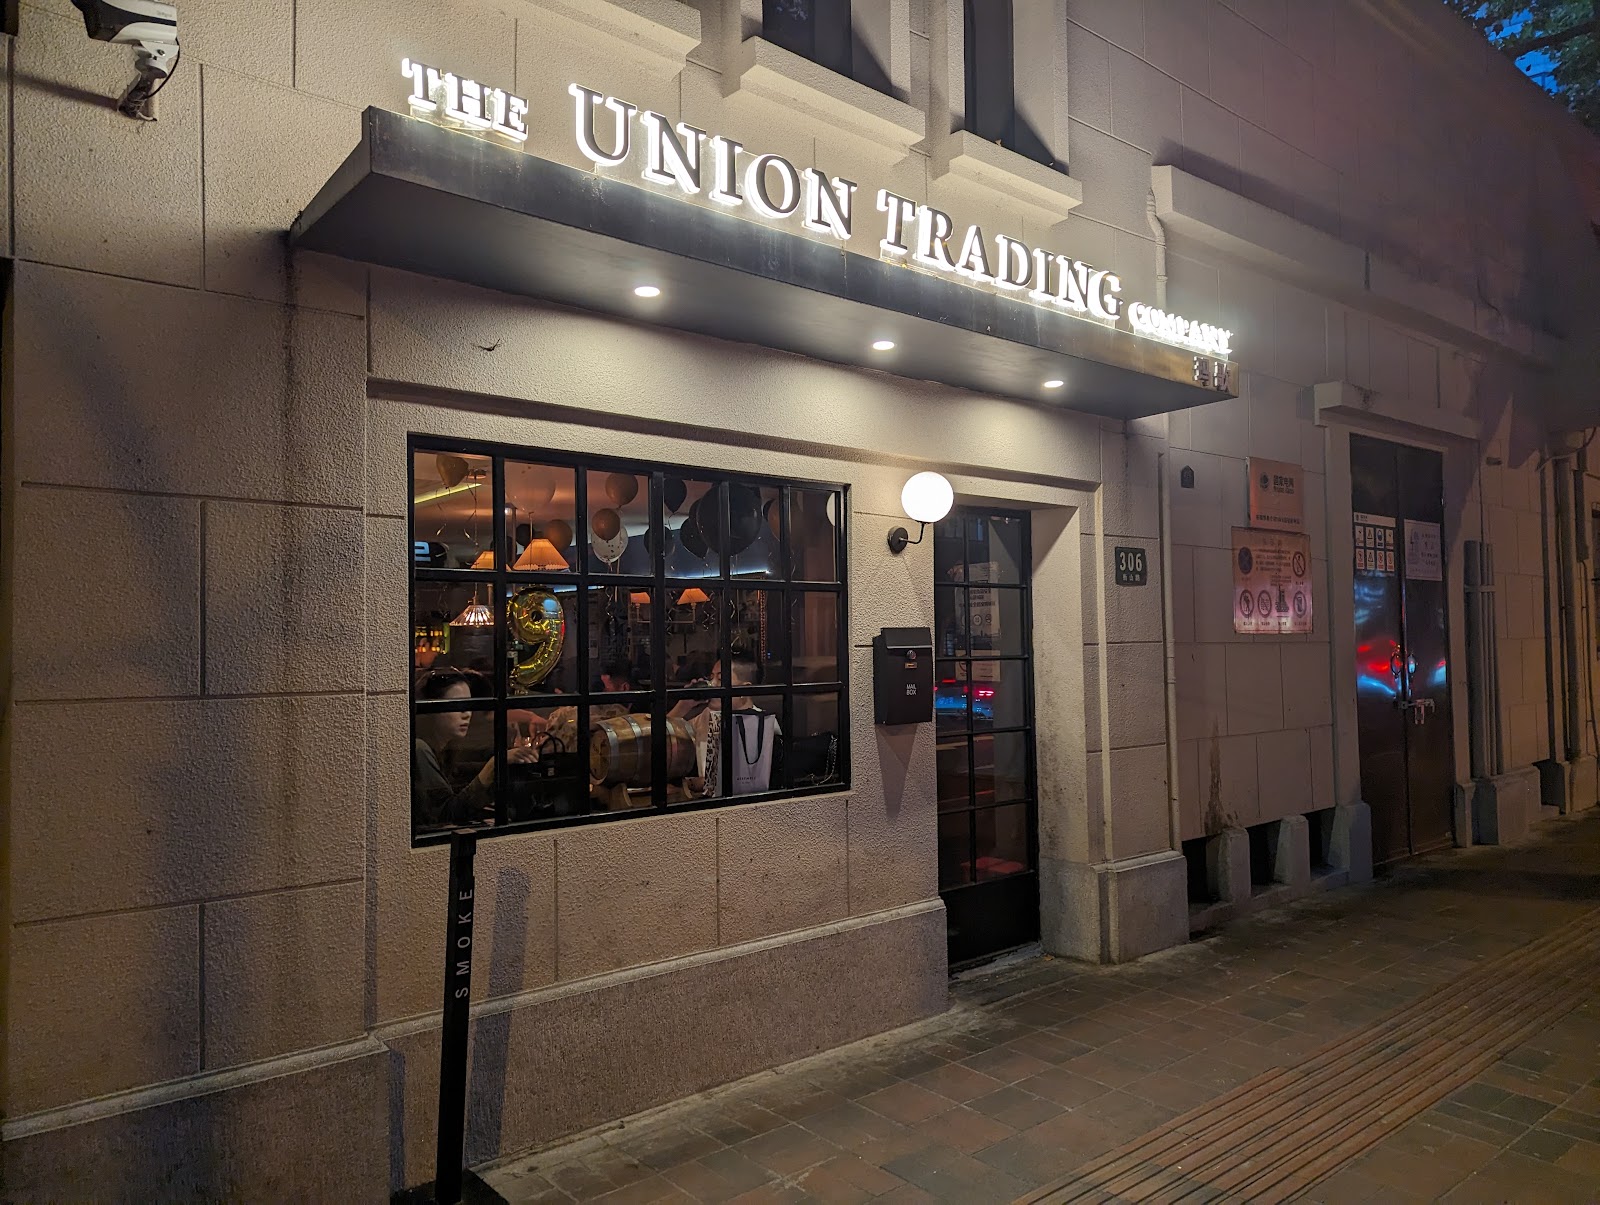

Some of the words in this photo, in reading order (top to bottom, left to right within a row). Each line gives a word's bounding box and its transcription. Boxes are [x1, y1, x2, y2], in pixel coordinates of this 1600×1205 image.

[402, 57, 529, 142] THE
[568, 83, 857, 240] UNION
[877, 188, 1123, 321] TRADING
[1128, 301, 1233, 354] COMPANY
[1119, 551, 1143, 572] 306
[455, 888, 473, 999] SMOKE
